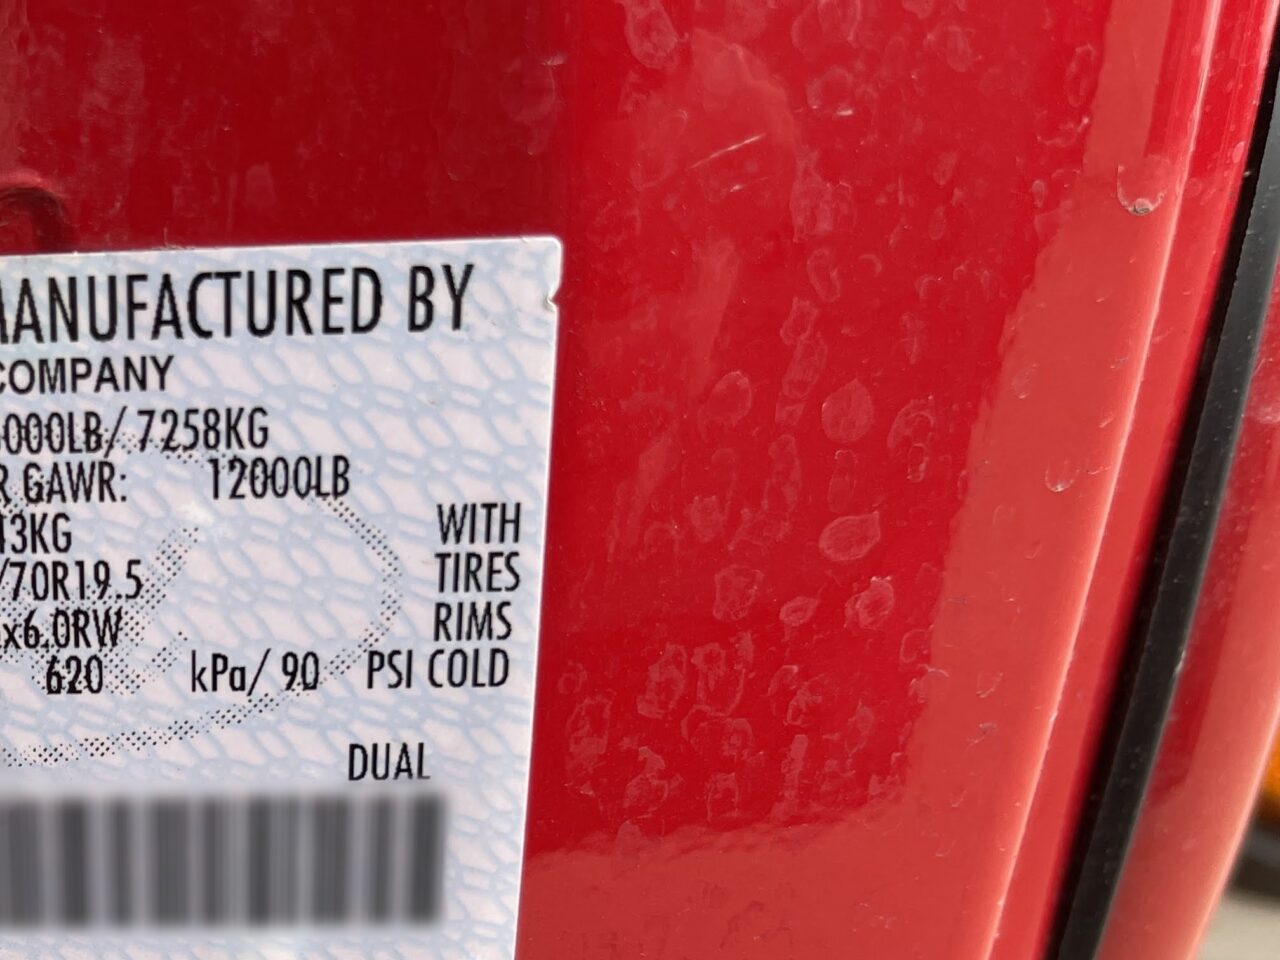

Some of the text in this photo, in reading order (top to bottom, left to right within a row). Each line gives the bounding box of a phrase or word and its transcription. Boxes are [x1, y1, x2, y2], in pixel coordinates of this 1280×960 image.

[408, 264, 476, 332] BY
[22, 461, 127, 502] GAWR:
[208, 455, 350, 499] 12000LB
[436, 502, 521, 544] WITH
[434, 551, 520, 593] TIRES
[433, 601, 512, 642] RIMS
[45, 654, 104, 695] 620
[191, 648, 271, 697] kPa/
[281, 651, 320, 692] 90
[366, 650, 413, 690] PSI
[427, 648, 510, 688] COLD
[348, 743, 431, 781] DUAL
